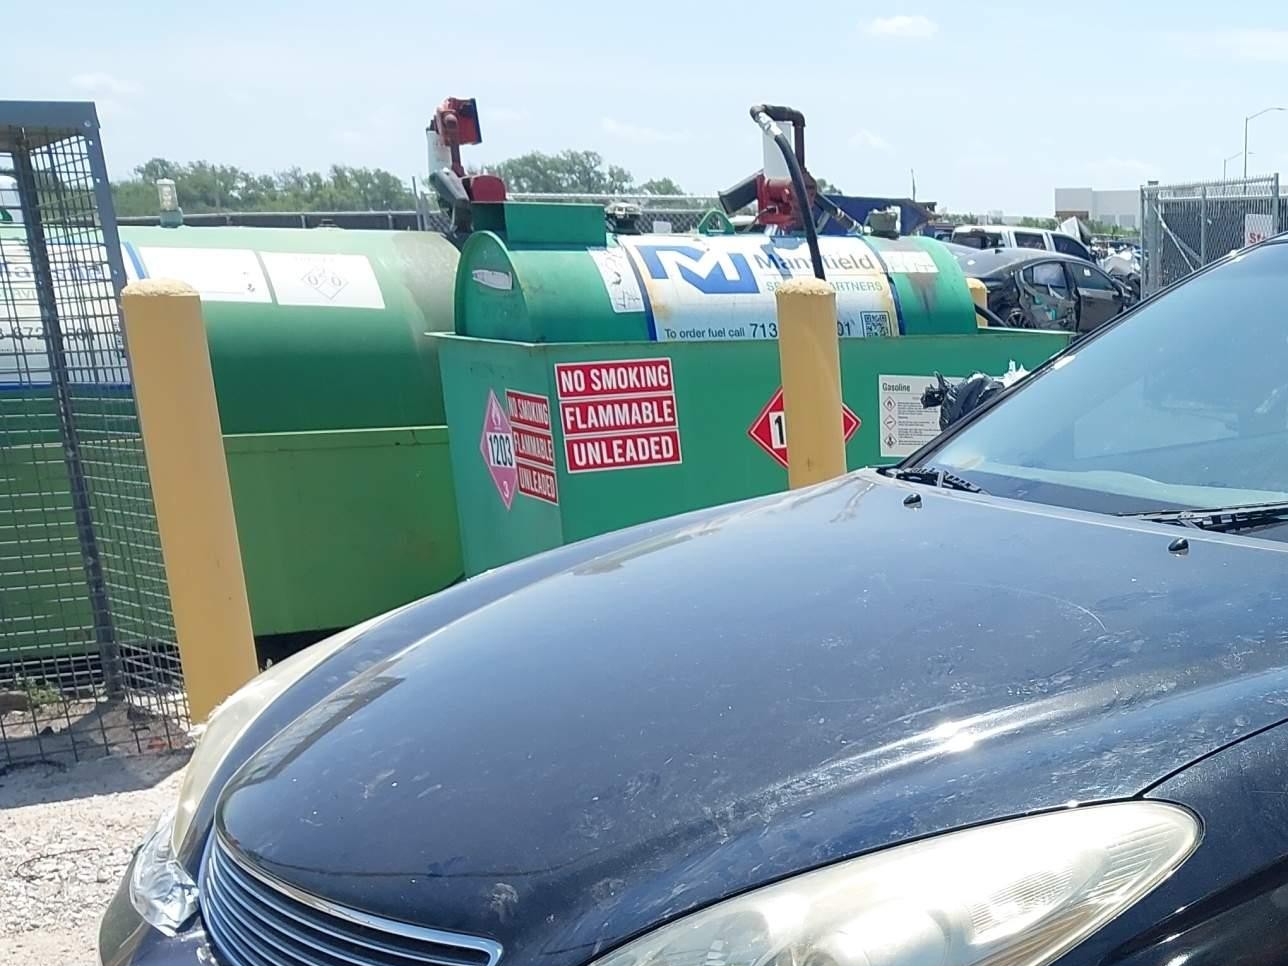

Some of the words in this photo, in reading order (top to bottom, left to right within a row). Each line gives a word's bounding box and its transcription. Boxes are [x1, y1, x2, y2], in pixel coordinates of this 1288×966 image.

[754, 254, 876, 270] Manfield
[664, 328, 677, 339] To
[679, 327, 705, 339] order
[708, 327, 726, 338] fuel
[728, 327, 745, 338] call
[560, 370, 586, 393] NO
[590, 365, 669, 391] SMOKING
[882, 382, 911, 393] Gasoline
[518, 398, 549, 426] SMOKING
[564, 400, 674, 431] FLAMMABLE
[488, 434, 513, 467] 1203
[513, 431, 554, 462] FLAMMABLE
[573, 435, 674, 467] UNLEADED
[502, 480, 510, 498] 3
[518, 465, 556, 498] UNLEADED
